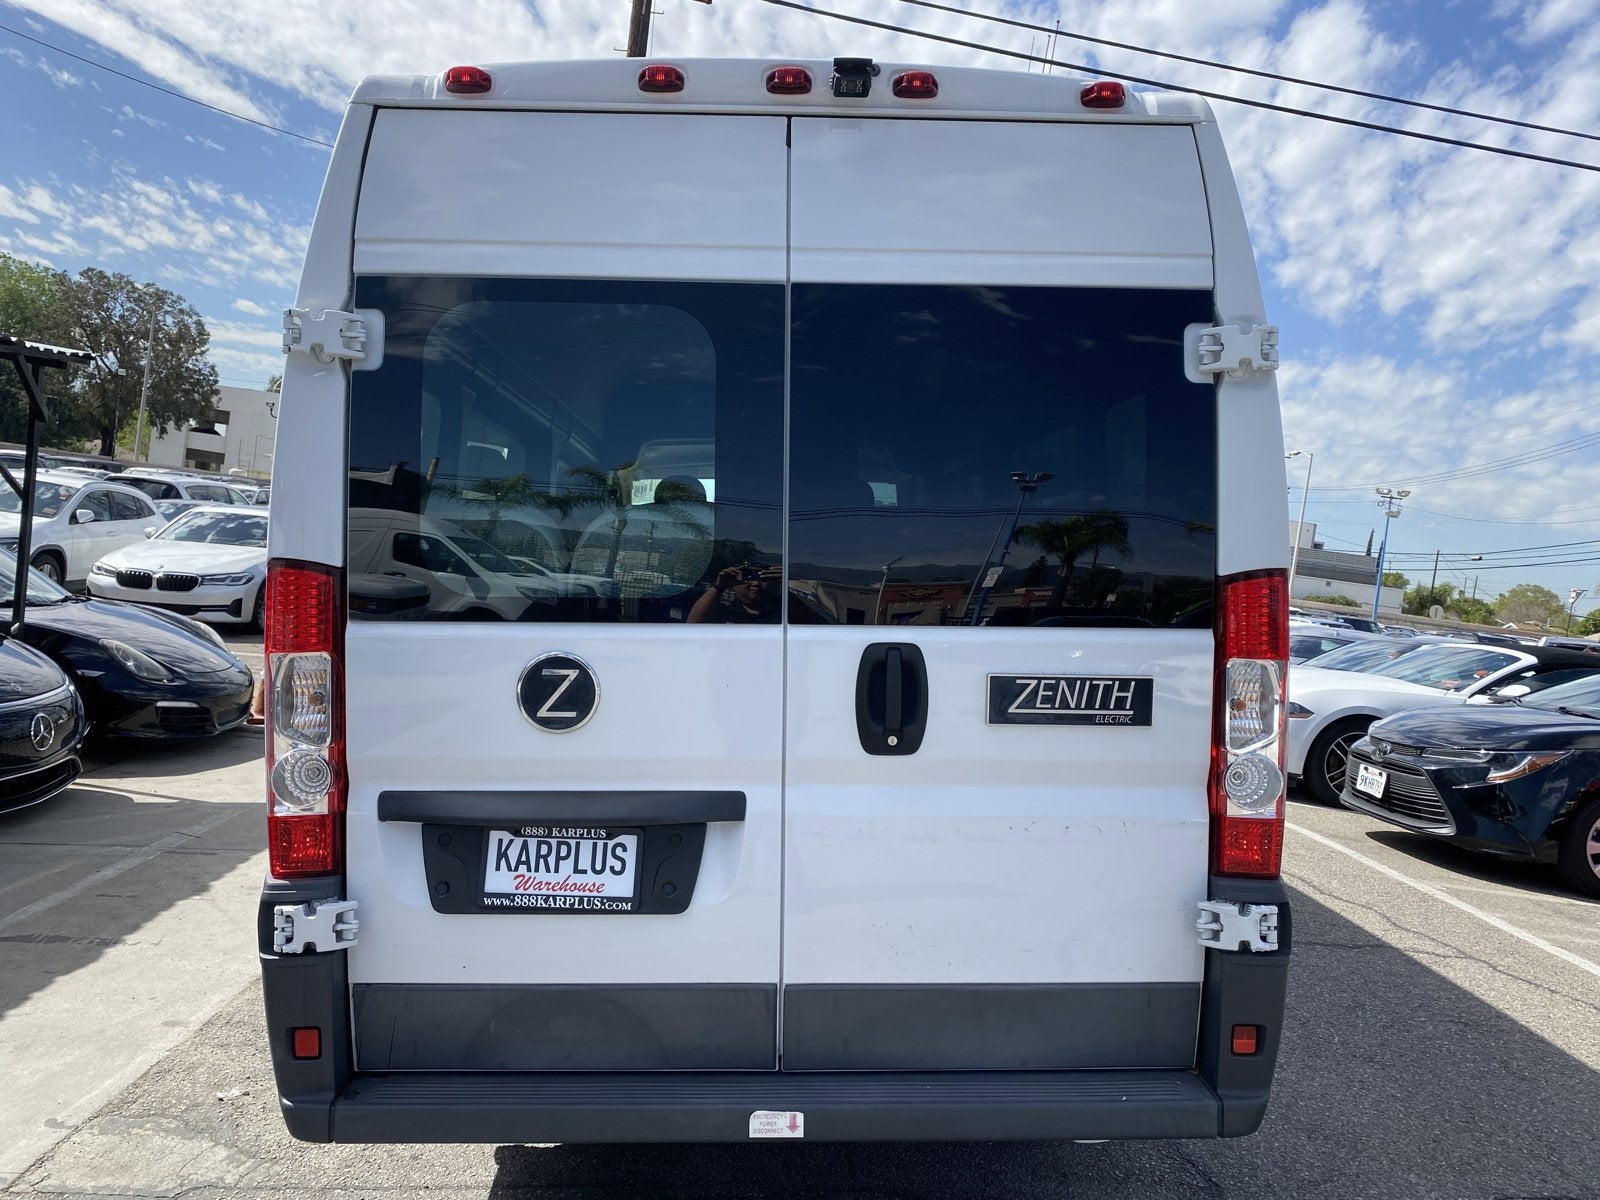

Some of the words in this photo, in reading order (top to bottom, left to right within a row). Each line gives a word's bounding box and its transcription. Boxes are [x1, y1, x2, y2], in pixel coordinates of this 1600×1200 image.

[536, 668, 580, 718] Z
[1008, 679, 1136, 714] ZENITH
[1095, 715, 1133, 724] ELECTRIC
[521, 826, 548, 837] (888)
[552, 827, 607, 839] KARPLUS
[494, 838, 628, 876] KARPLUS
[513, 874, 606, 894] Warehouse
